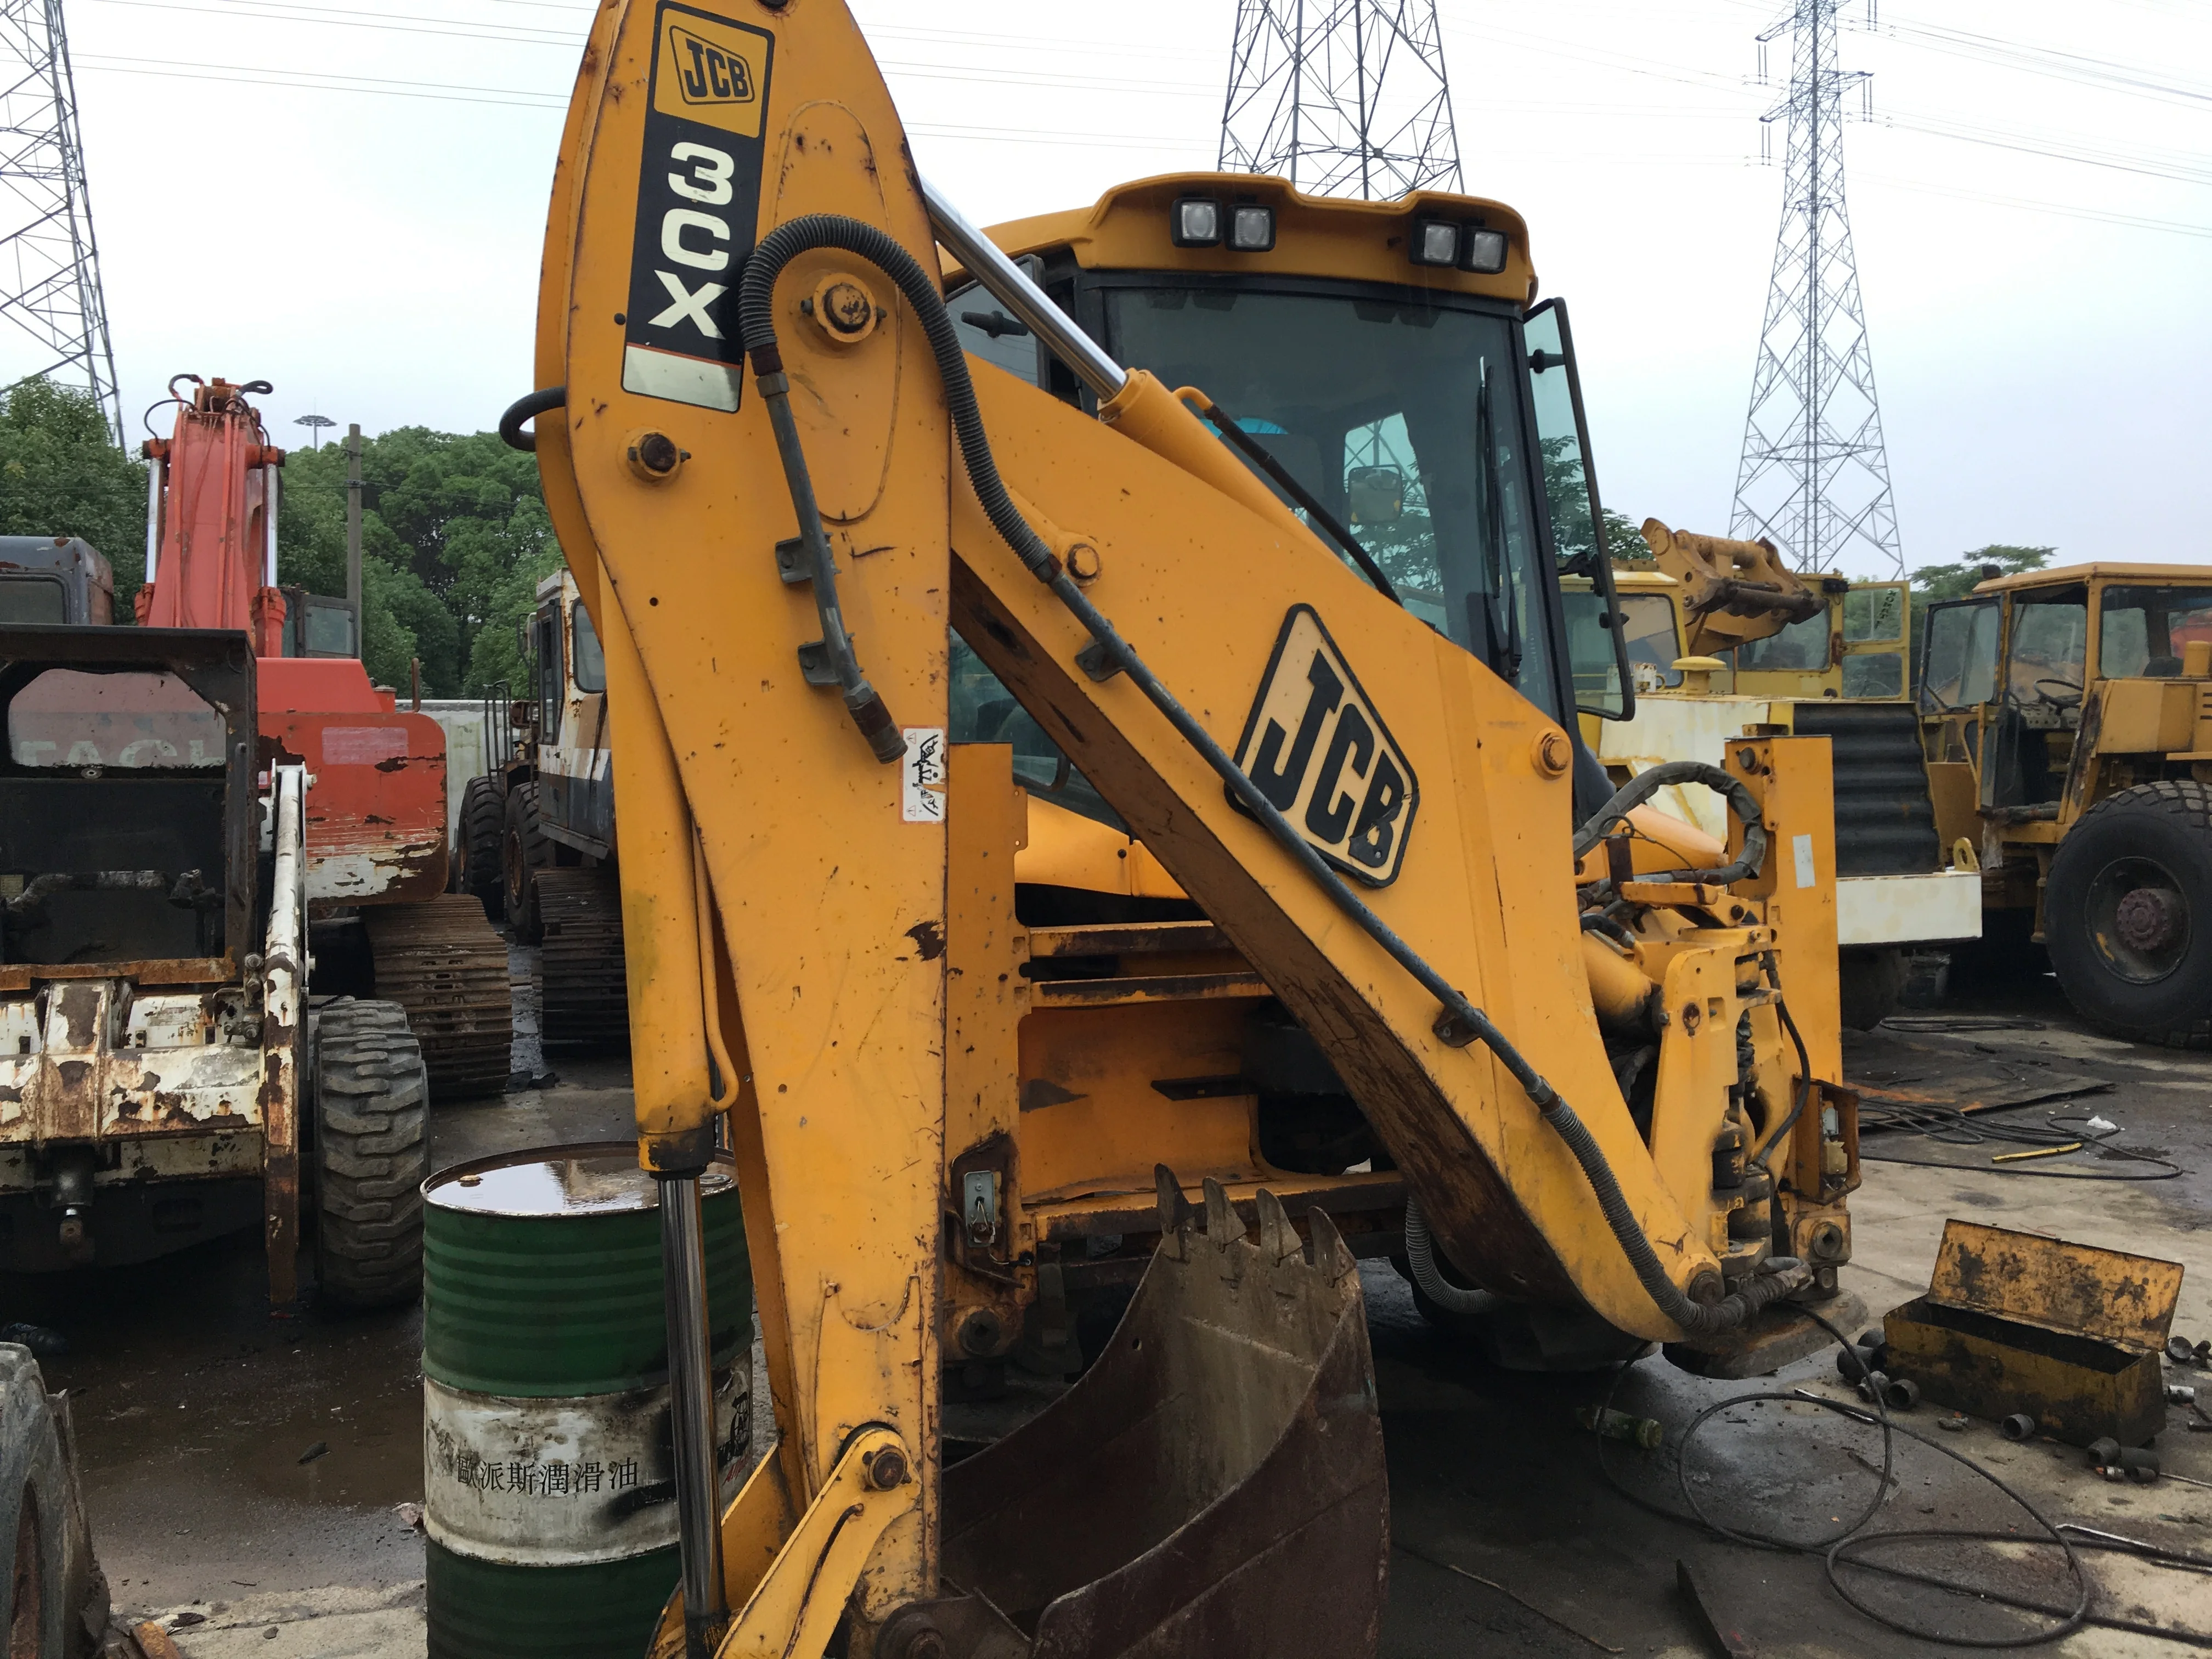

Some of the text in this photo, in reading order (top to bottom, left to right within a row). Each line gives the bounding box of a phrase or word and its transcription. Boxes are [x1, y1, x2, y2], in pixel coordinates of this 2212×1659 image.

[684, 37, 749, 98] JCB
[648, 142, 735, 340] 3CX
[1248, 648, 1405, 868] JCB
